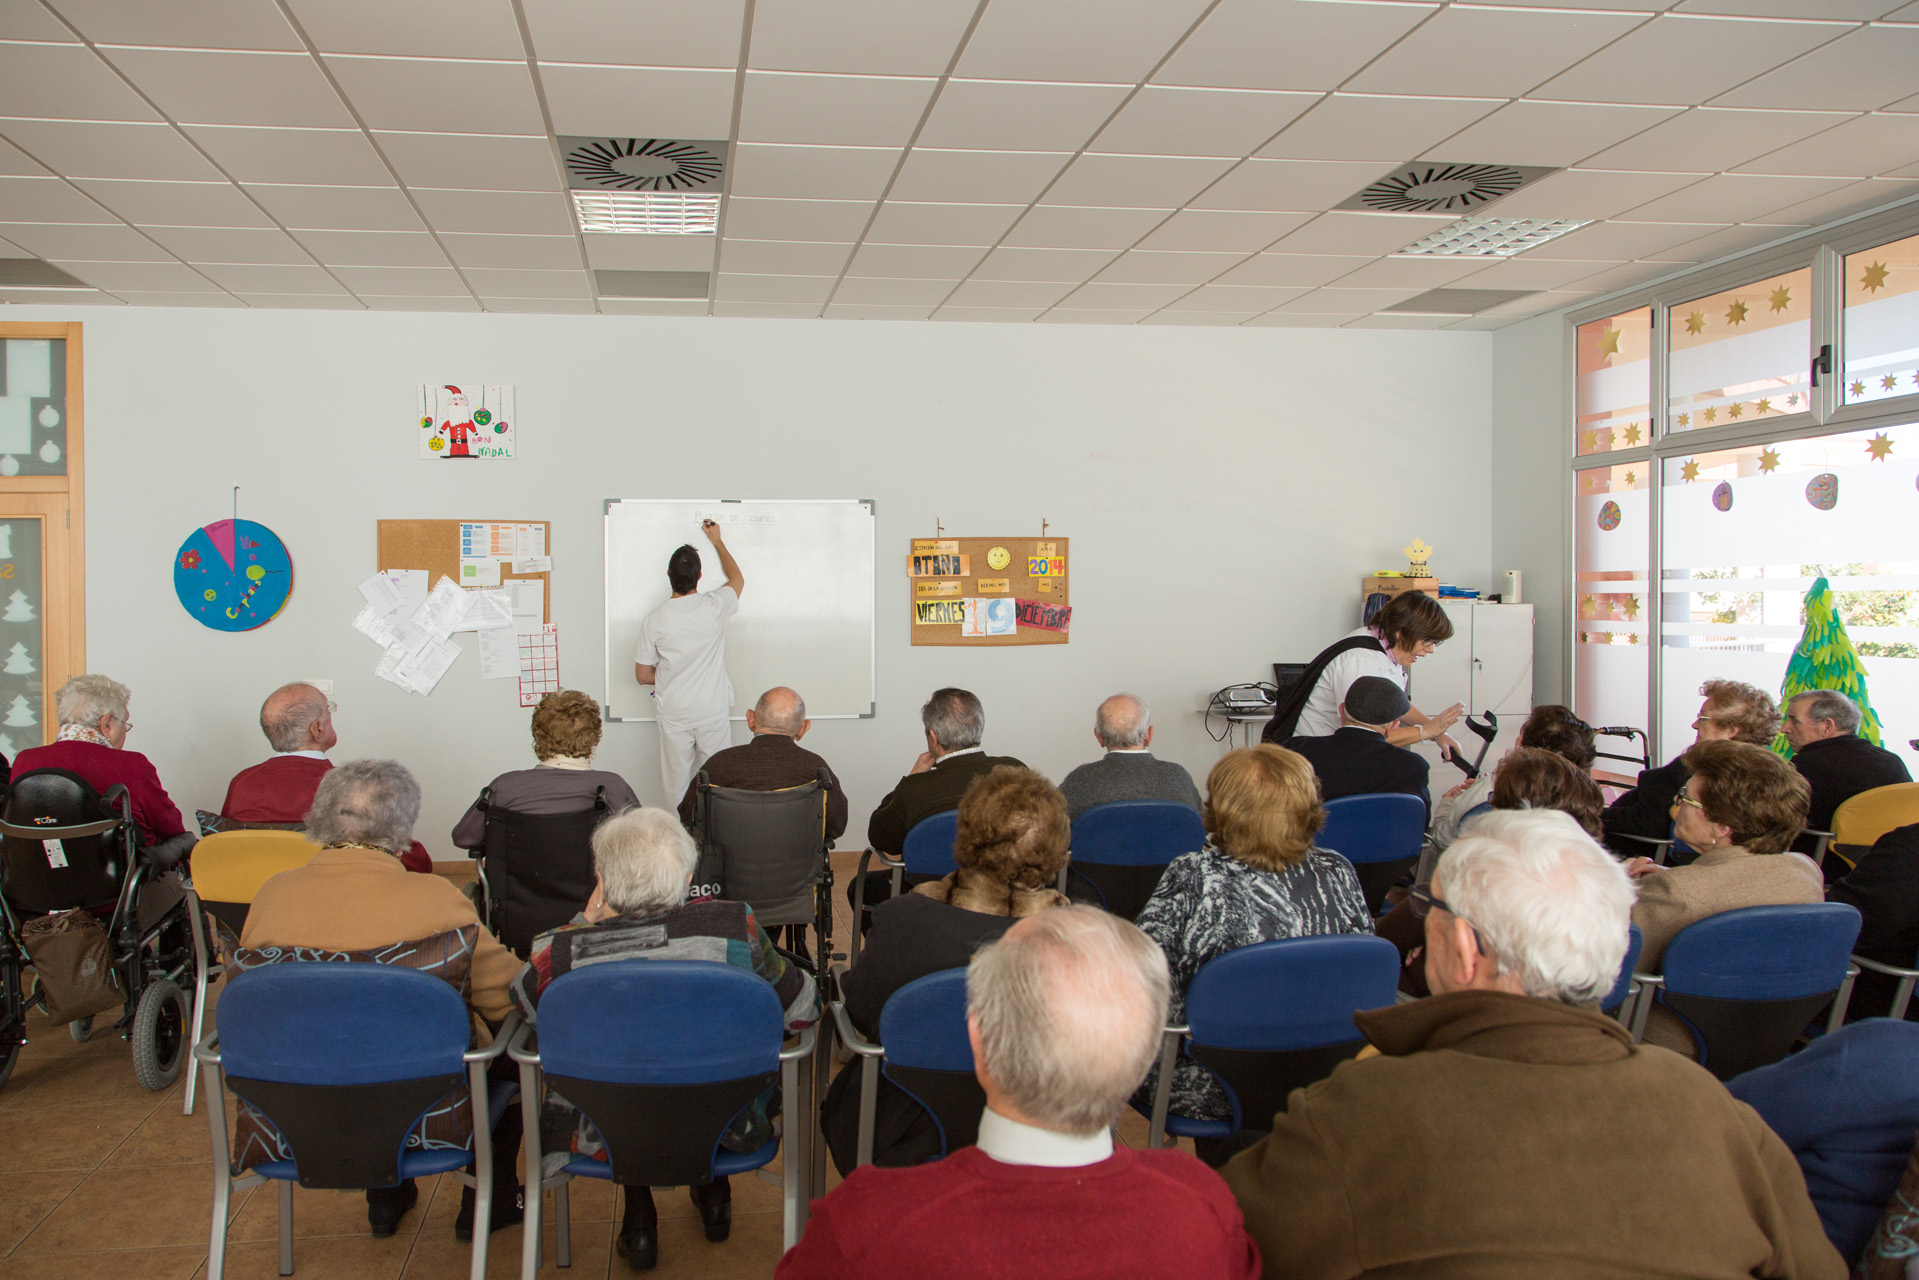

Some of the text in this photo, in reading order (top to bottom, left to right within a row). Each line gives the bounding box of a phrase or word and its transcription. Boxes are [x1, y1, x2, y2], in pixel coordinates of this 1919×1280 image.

[471, 435, 491, 444] BON
[478, 446, 512, 458] NADAL
[1029, 558, 1064, 575] 2014
[916, 601, 965, 623] VIERNES
